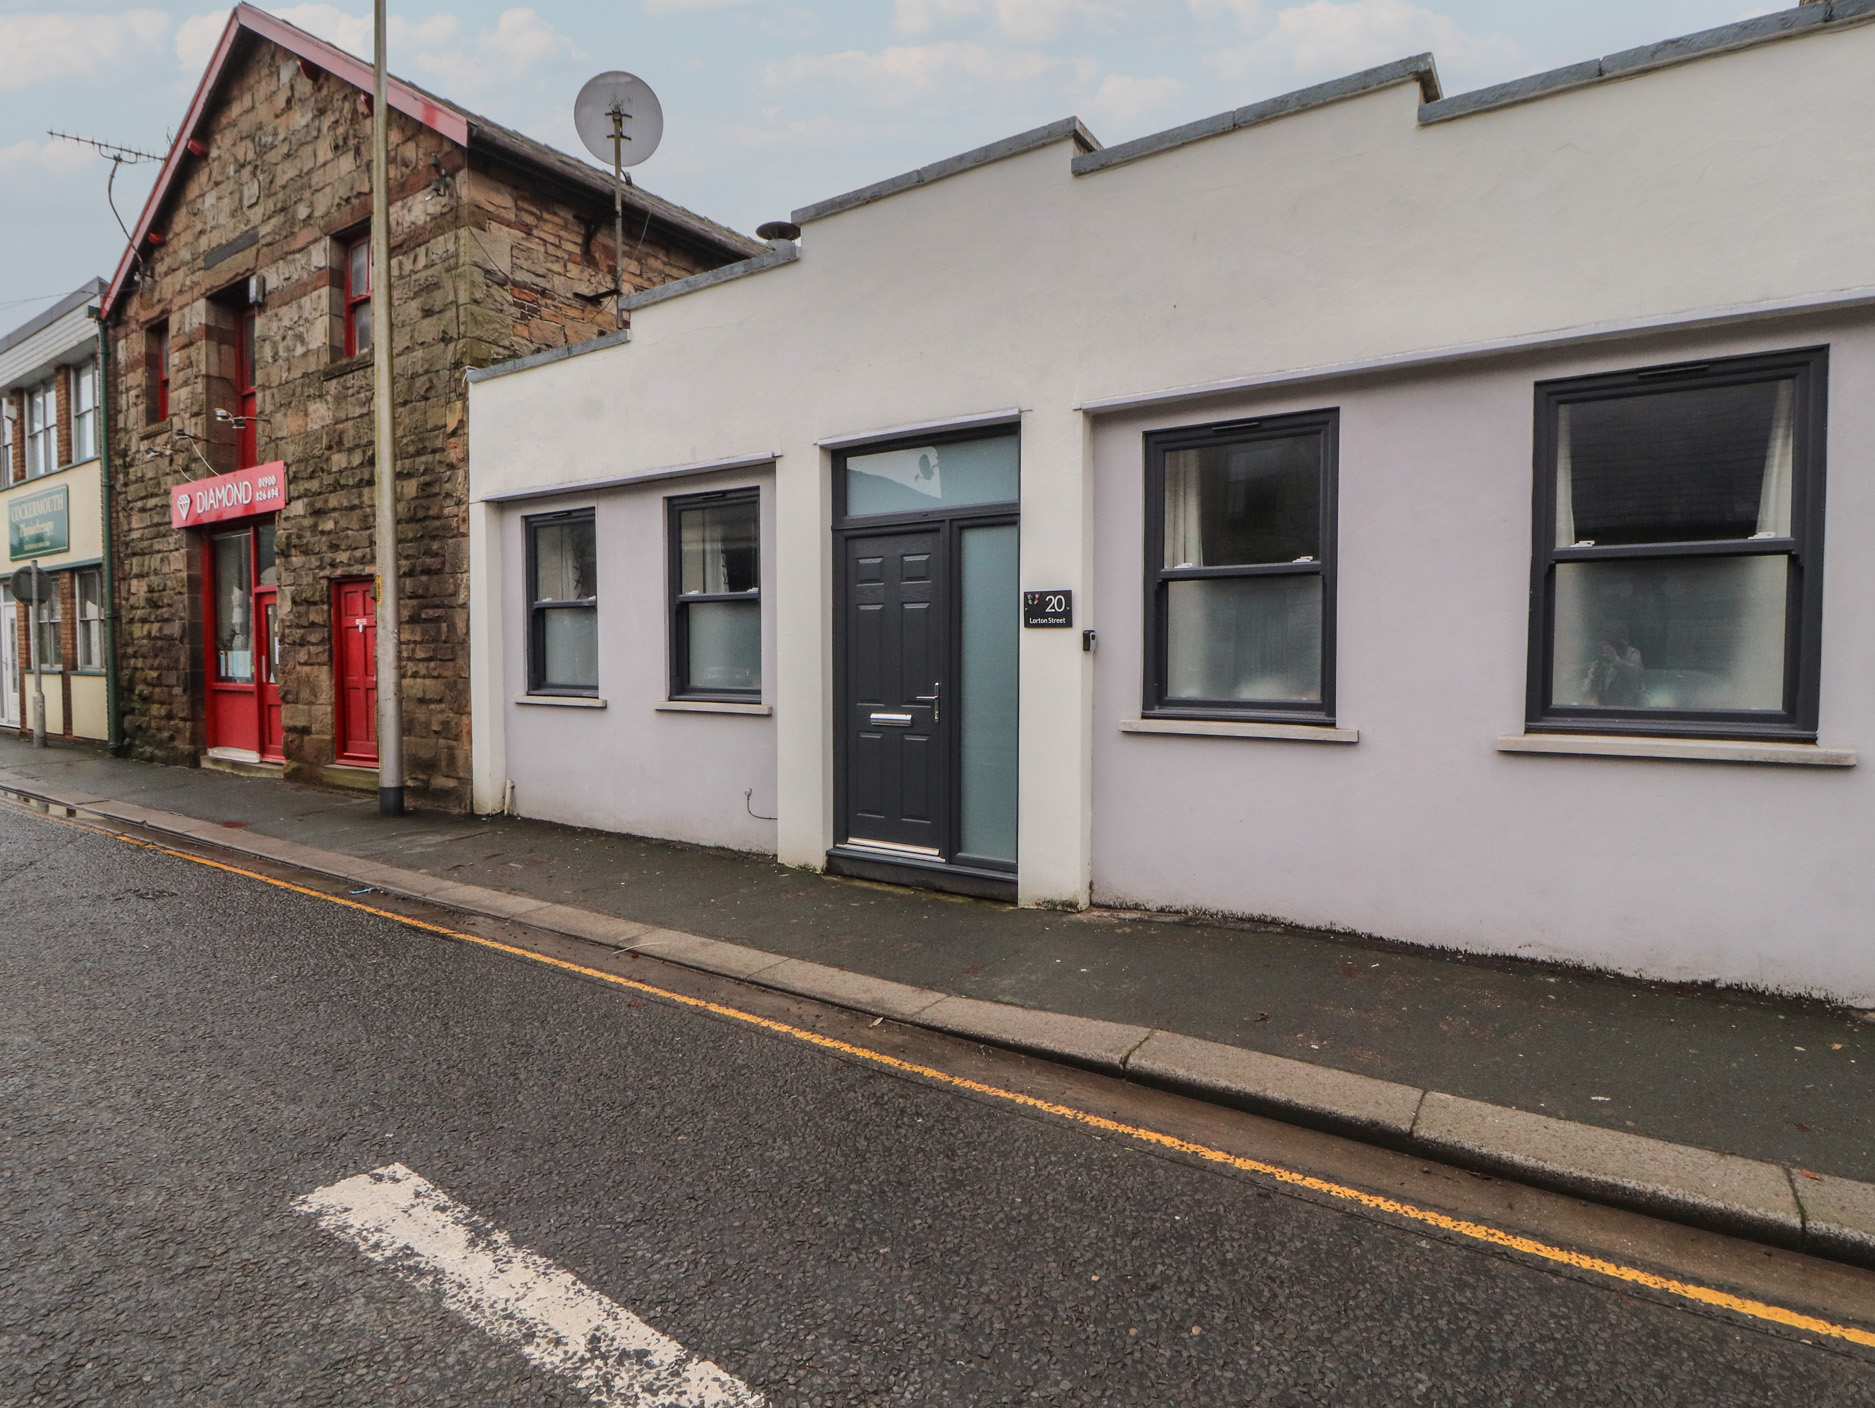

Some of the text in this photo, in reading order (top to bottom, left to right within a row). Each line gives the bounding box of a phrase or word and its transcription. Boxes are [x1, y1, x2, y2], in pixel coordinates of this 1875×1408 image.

[258, 475, 277, 488] 01900
[196, 481, 253, 514] DIAMOND
[256, 487, 279, 502] 826 694
[1045, 595, 1066, 613] 20
